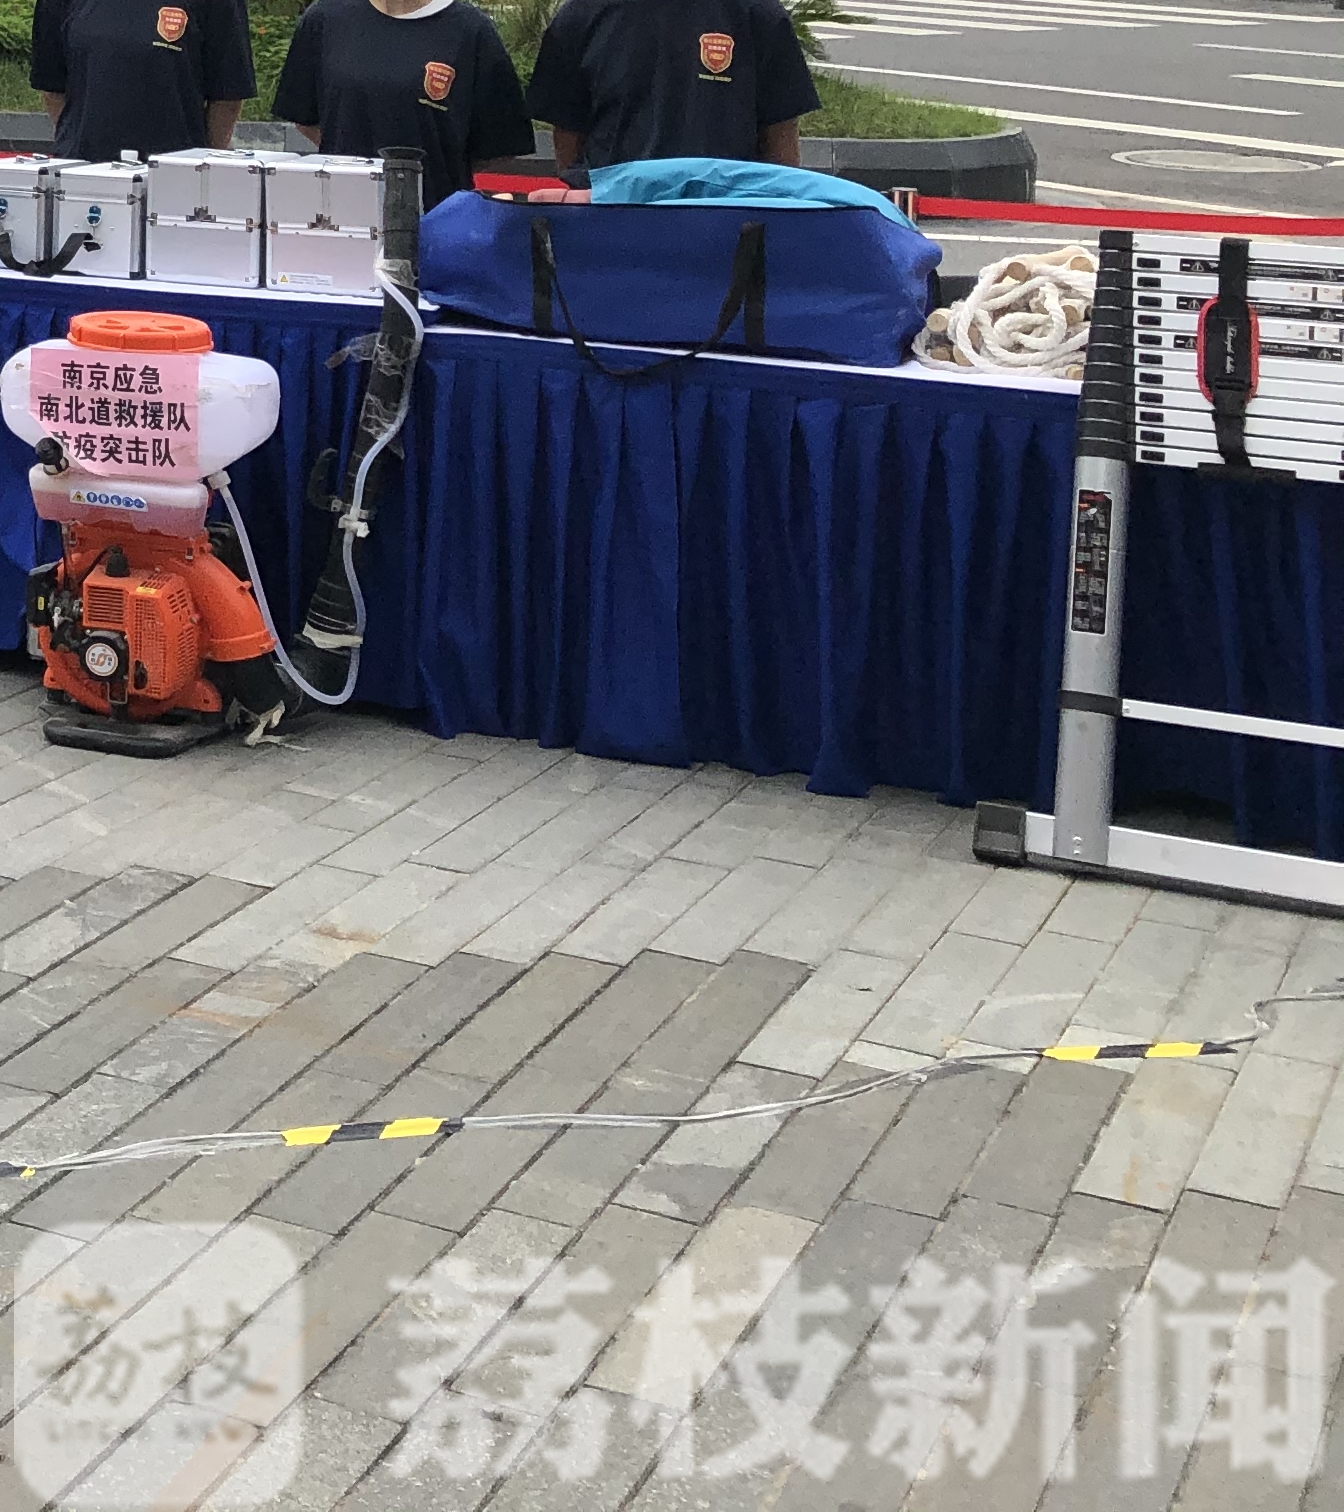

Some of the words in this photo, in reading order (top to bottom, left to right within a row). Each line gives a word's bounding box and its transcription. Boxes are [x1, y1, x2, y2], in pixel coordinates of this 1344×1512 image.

[61, 360, 162, 394] 南京应急
[38, 393, 191, 432] 南北道救援队
